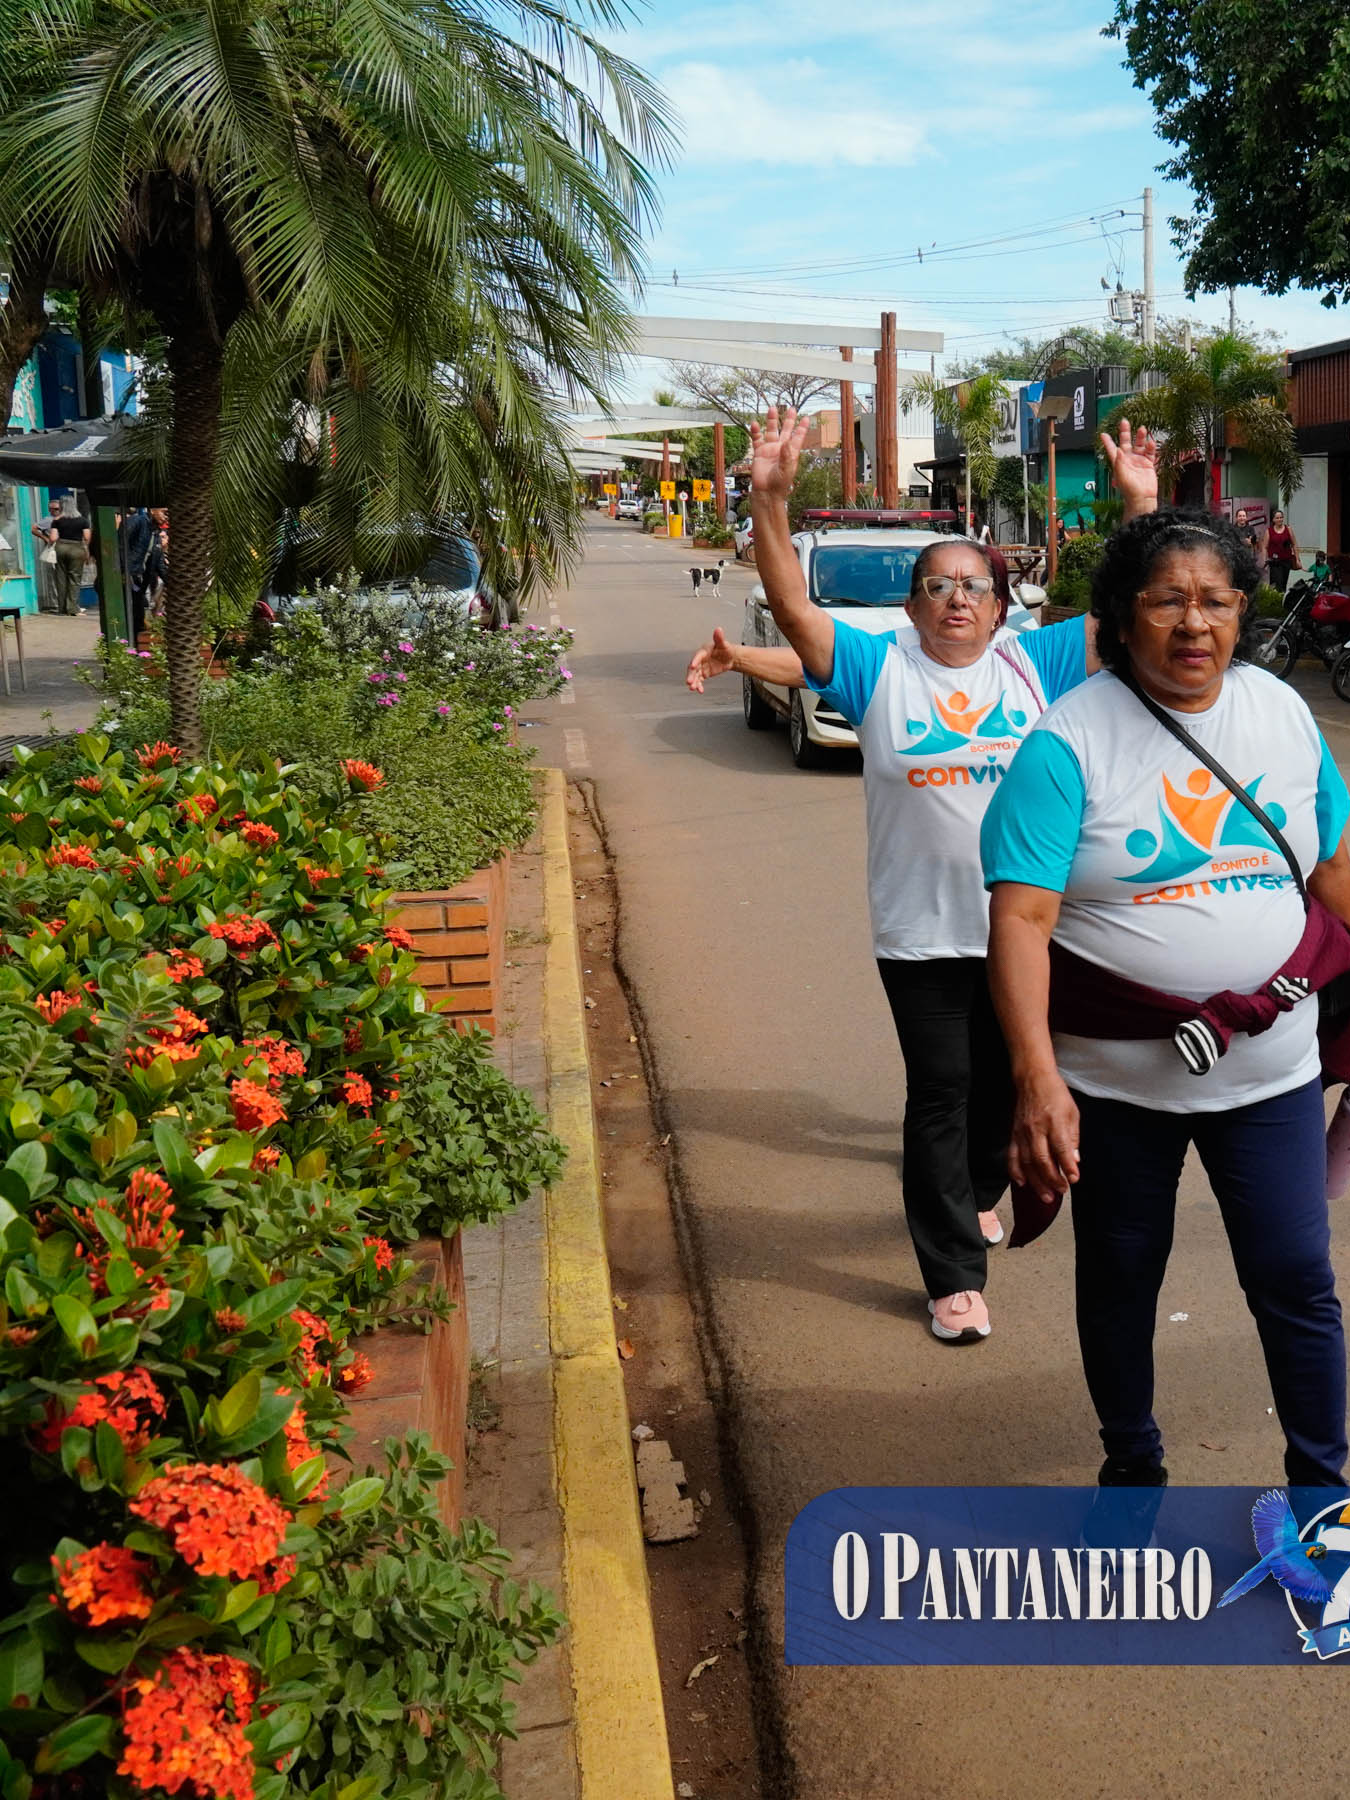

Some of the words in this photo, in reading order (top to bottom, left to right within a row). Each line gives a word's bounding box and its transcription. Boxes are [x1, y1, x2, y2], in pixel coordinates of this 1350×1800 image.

[969, 741, 1010, 753] BONITO
[1211, 856, 1260, 874] BONITO
[1262, 852, 1270, 866] É
